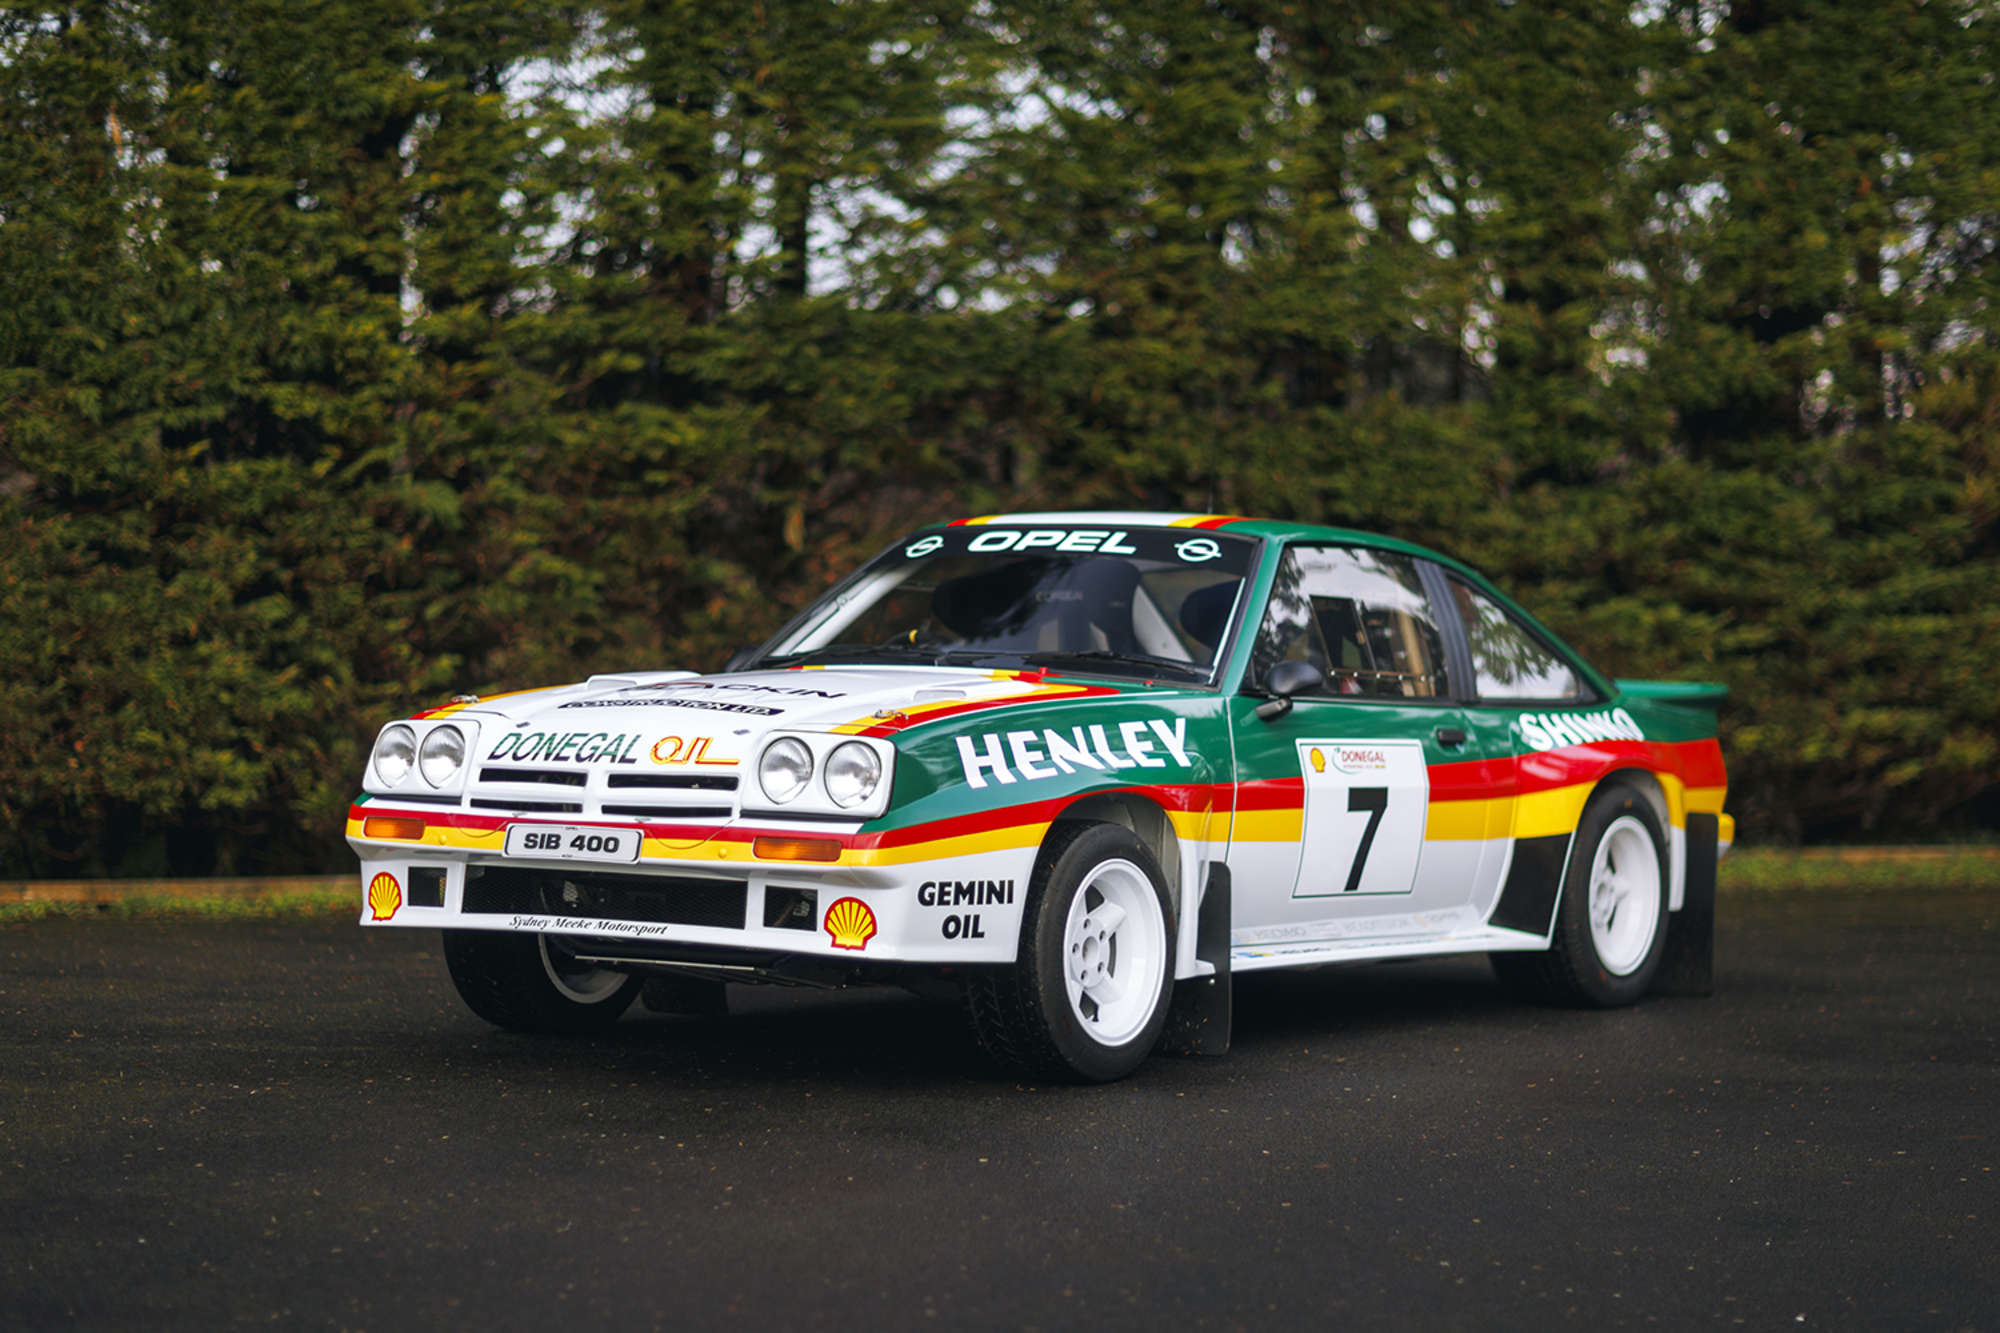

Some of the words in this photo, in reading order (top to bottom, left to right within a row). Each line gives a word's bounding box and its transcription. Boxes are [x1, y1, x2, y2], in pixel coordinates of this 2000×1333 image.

[967, 530, 1137, 555] OPEL
[1519, 706, 1646, 751] SHINKO
[487, 732, 642, 764] DONEGAL
[649, 735, 741, 765] OIL
[955, 717, 1193, 789] HENLEY
[1341, 751, 1385, 763] DONEGAL
[523, 833, 562, 850] SIB
[569, 834, 620, 853] 400
[1344, 786, 1389, 892] 7
[917, 879, 1015, 907] GEMINI
[509, 915, 551, 931] Sydney
[552, 917, 593, 930] Meeke
[594, 920, 668, 936] Motorsport
[941, 913, 985, 940] OIL
